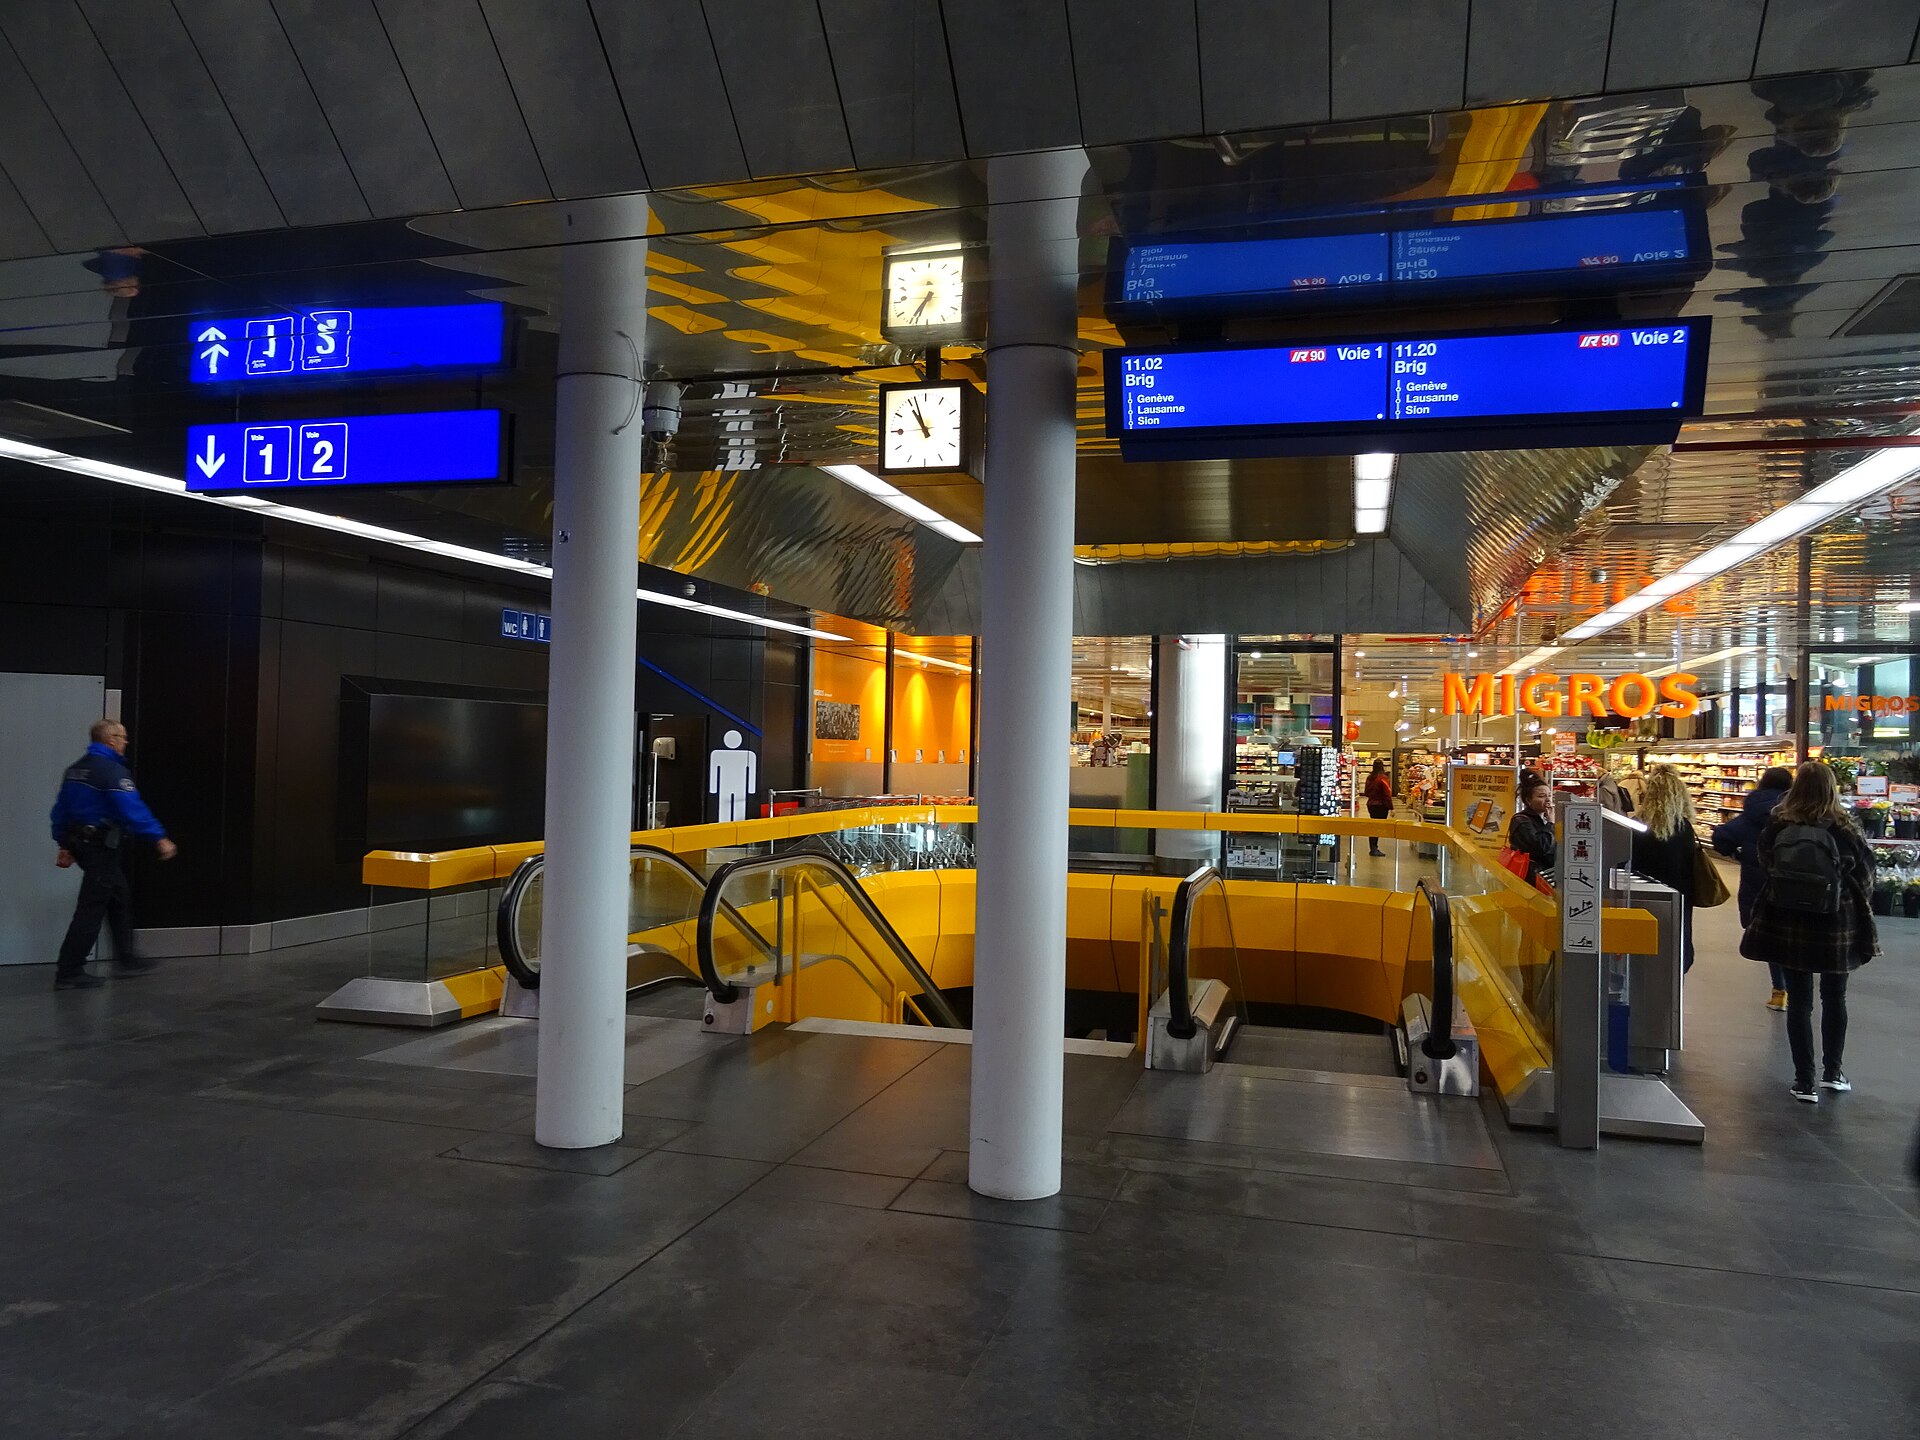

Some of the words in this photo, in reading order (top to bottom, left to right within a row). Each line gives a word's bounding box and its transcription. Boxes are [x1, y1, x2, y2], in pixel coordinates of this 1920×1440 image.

[1395, 343, 1437, 358] 11.20
[1602, 334, 1618, 346] 90
[1632, 331, 1668, 346] Voie
[1672, 330, 1684, 344] 2
[1125, 358, 1162, 371] 11.02
[1310, 350, 1325, 360] 90
[1337, 346, 1370, 360] Voie
[1375, 346, 1383, 358] 1
[1395, 360, 1426, 376] Brig
[1125, 374, 1155, 388] Brig
[1406, 380, 1448, 392] Genève
[1137, 393, 1174, 404] Genève
[1406, 393, 1459, 404] Lausanne
[1137, 404, 1186, 414] Lausanne
[1406, 405, 1430, 415] Sion
[1137, 416, 1160, 426] Sion
[259, 444, 273, 475] 1
[312, 440, 334, 473] 2
[504, 622, 518, 634] WC
[1443, 672, 1700, 718] MIGROS
[1825, 694, 1920, 711] MIGROS
[1461, 774, 1476, 782] VOUS
[1478, 774, 1492, 784] AVEZ
[1494, 776, 1509, 784] TOUT
